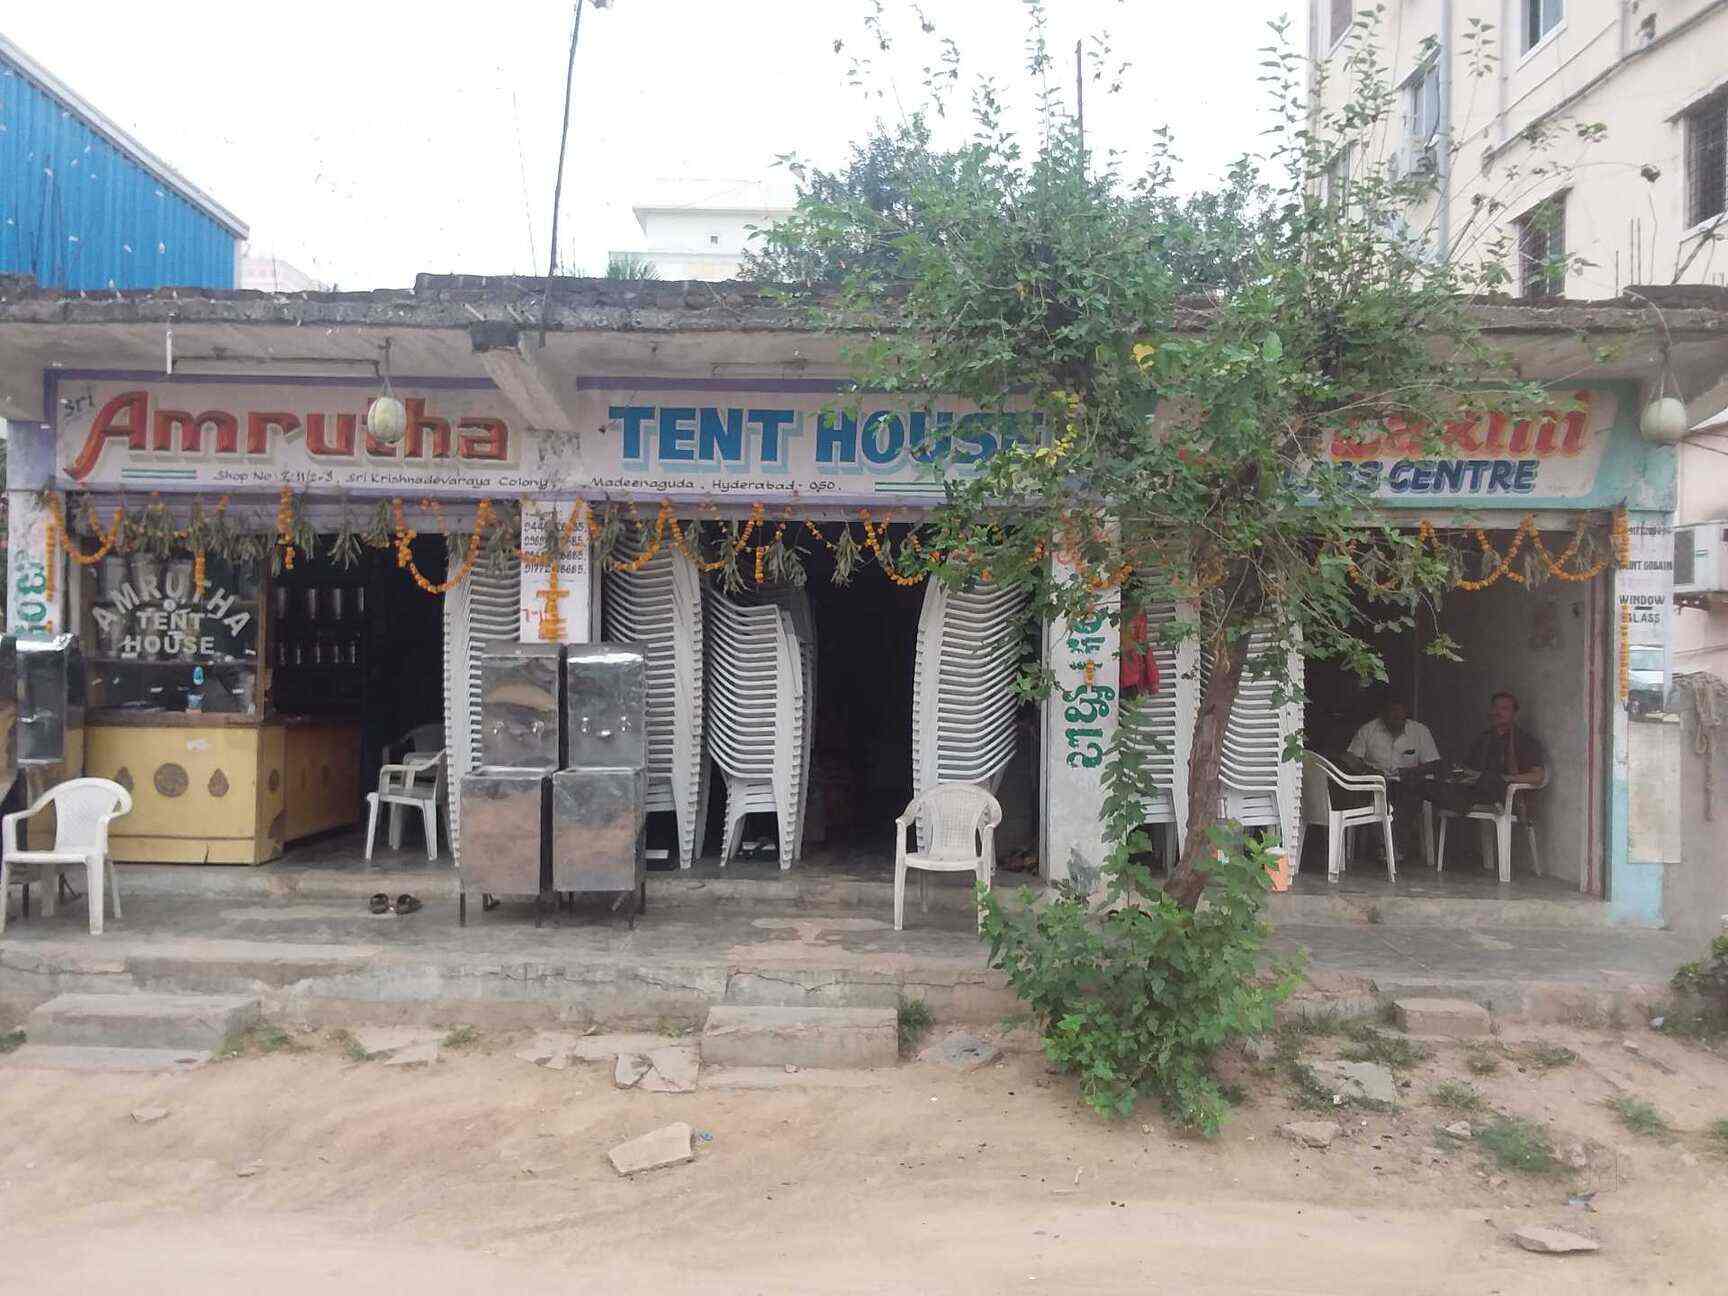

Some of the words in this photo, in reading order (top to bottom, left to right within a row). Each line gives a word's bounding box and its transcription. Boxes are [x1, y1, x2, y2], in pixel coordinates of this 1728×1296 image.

[608, 406, 795, 462] TENT
[214, 470, 249, 484] Shop
[1388, 458, 1540, 492] CENTRE
[1618, 594, 1666, 605] WINDOW
[135, 607, 202, 632] TENT
[121, 634, 216, 656] HOUSE
